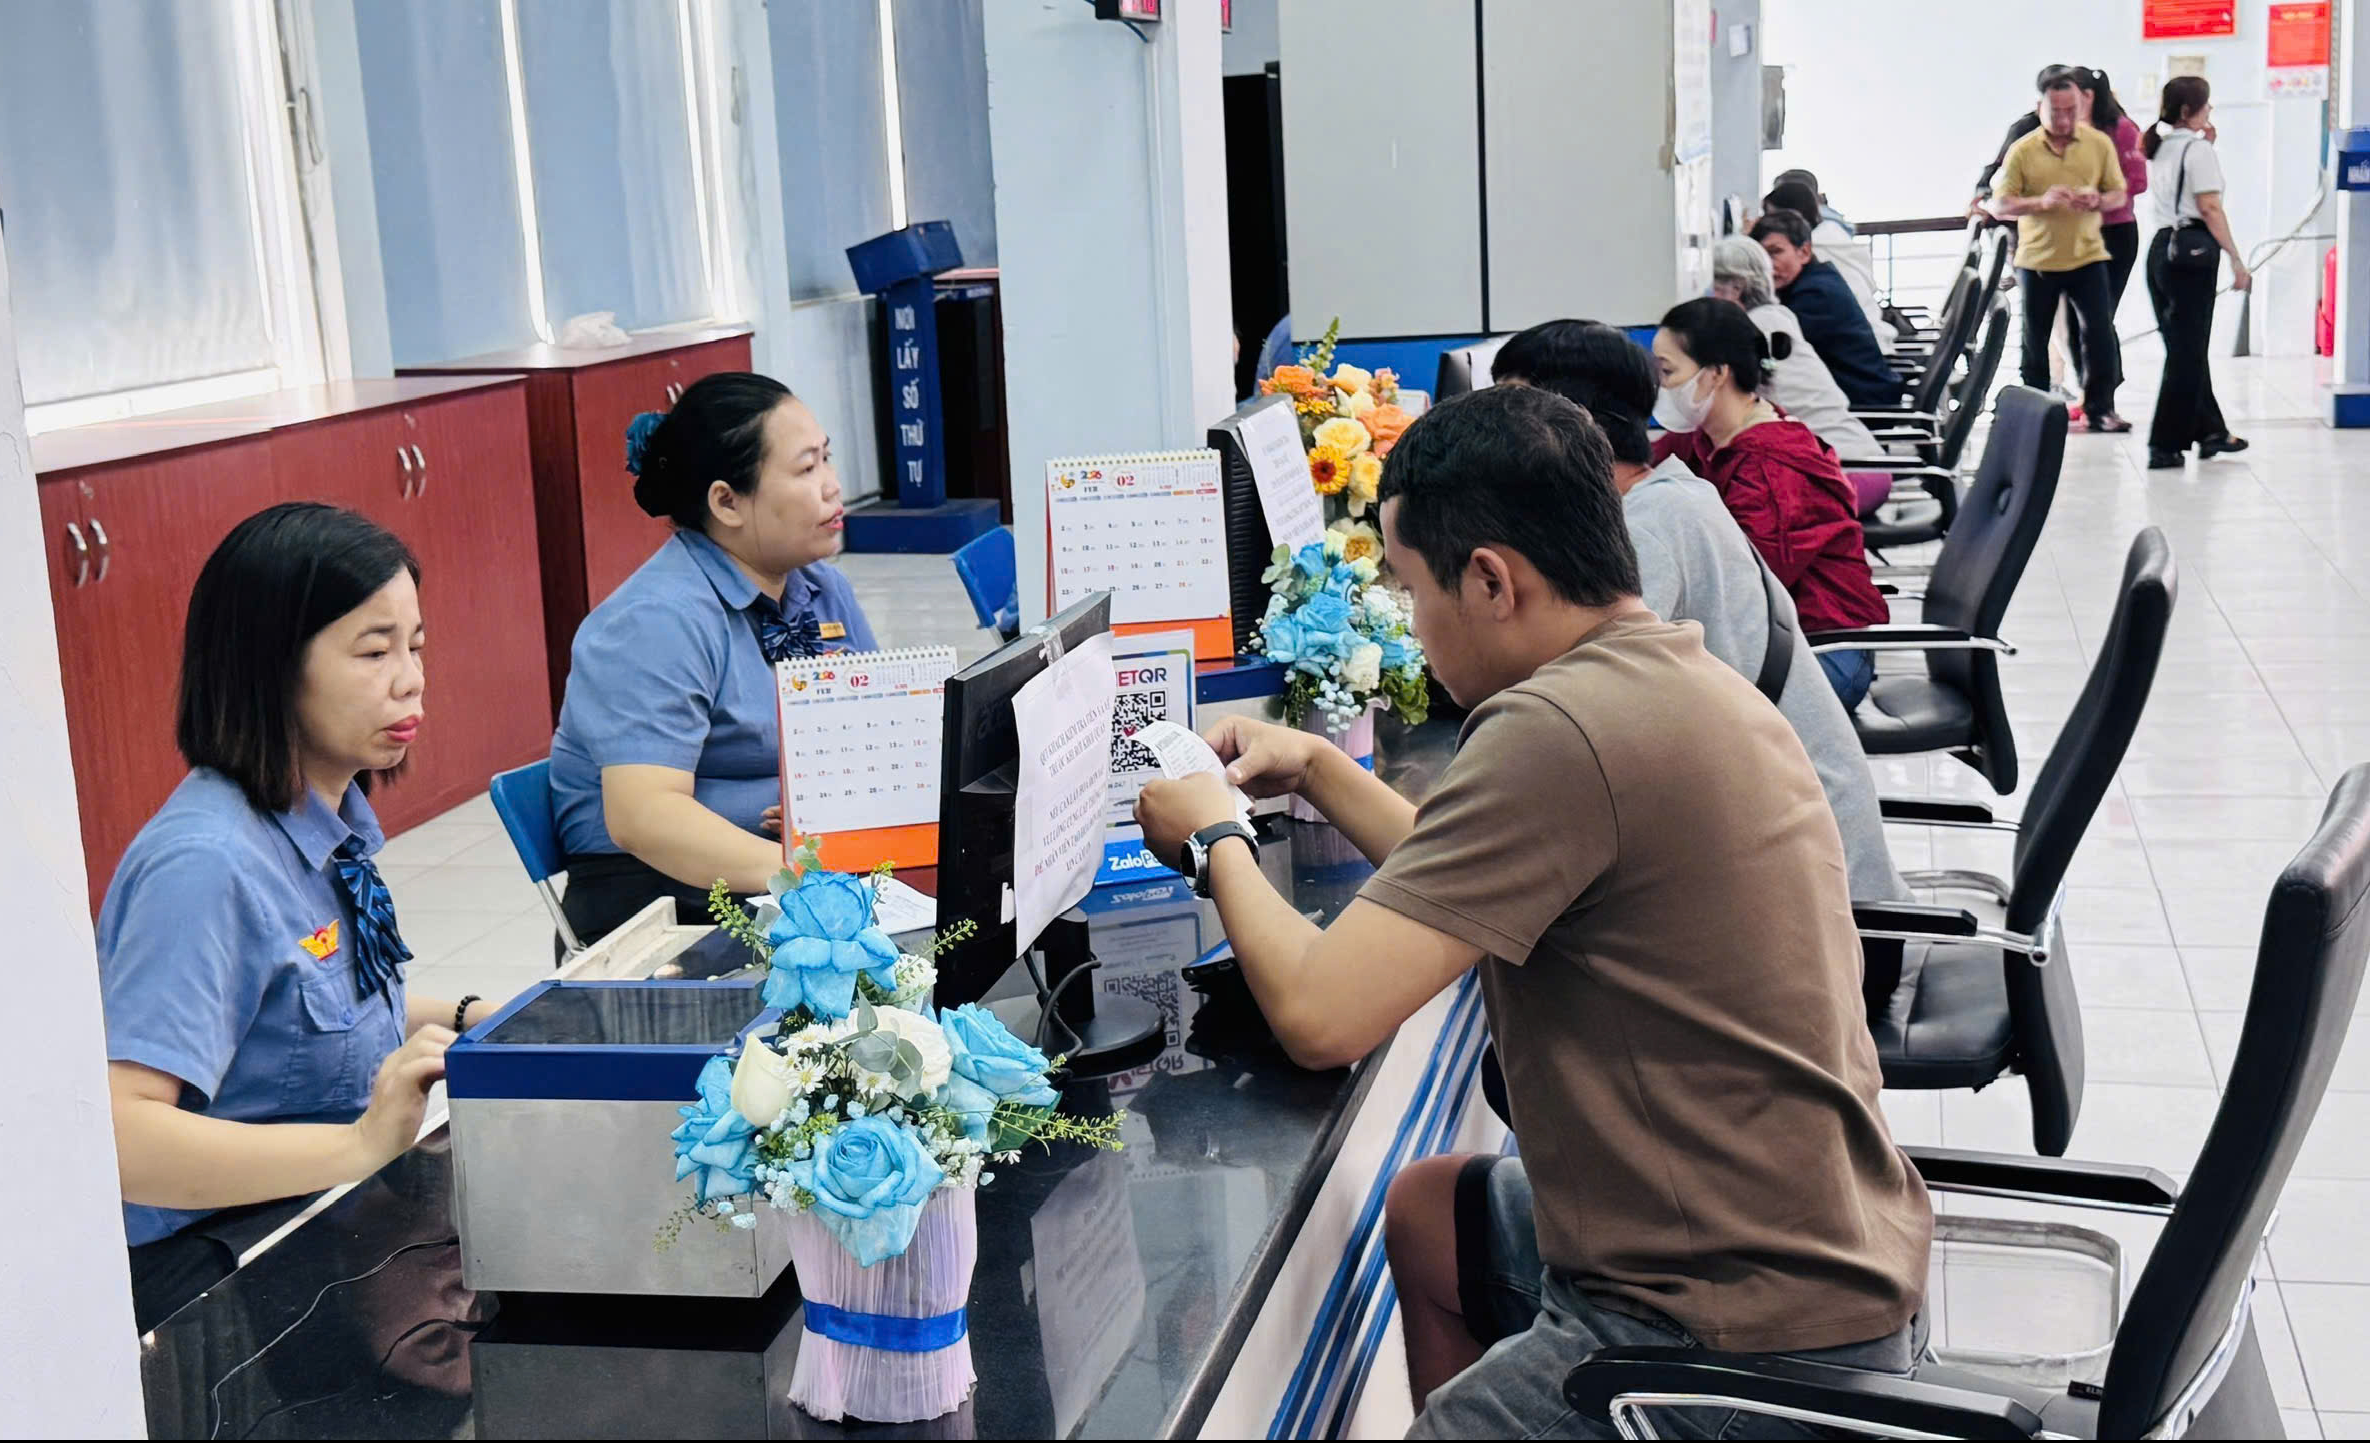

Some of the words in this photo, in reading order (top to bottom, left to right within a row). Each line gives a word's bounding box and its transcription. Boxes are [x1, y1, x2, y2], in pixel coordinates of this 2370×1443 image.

[894, 304, 915, 330] NƠI
[896, 338, 919, 369] LẤY
[902, 378, 919, 409] SỐ
[900, 419, 924, 446] THỨ
[907, 459, 923, 487] TỰ
[1116, 475, 1135, 487] 02
[850, 675, 869, 688] 02
[1118, 667, 1167, 687] ETQR
[1108, 848, 1163, 871] ZaloP
